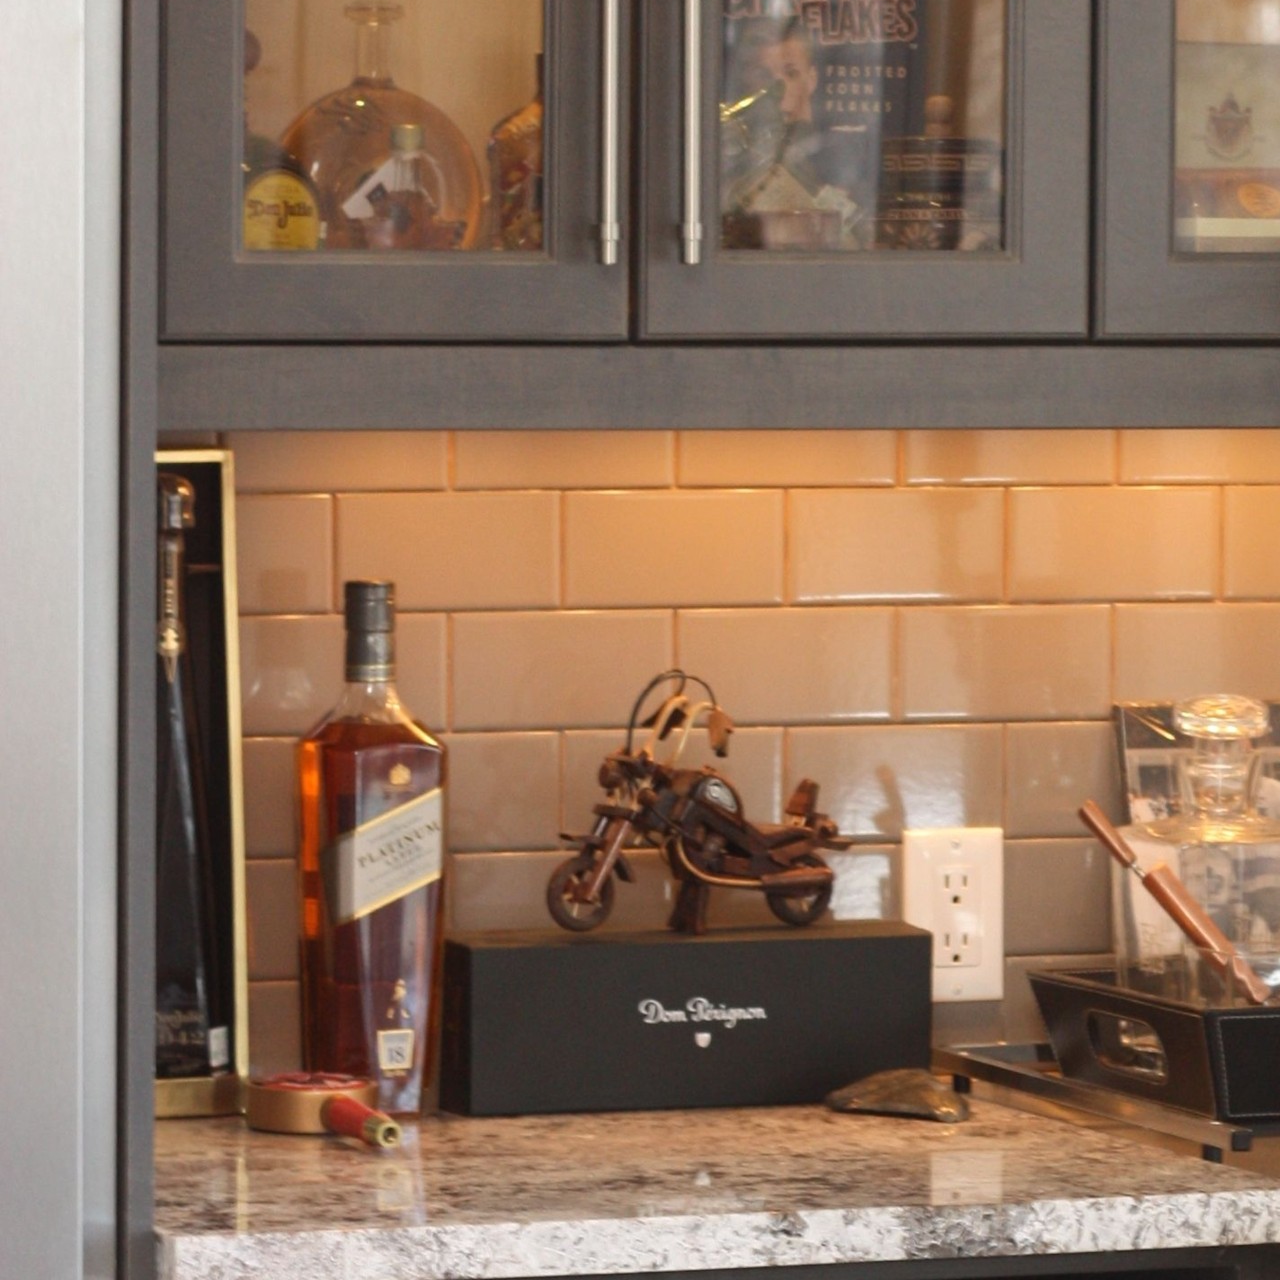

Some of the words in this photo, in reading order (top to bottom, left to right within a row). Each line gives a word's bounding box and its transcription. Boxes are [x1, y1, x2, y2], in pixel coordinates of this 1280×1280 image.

[826, 66, 907, 79] FROSTED
[826, 83, 874, 95] CORN
[826, 100, 892, 113] FLAKES
[638, 998, 688, 1024] Dom
